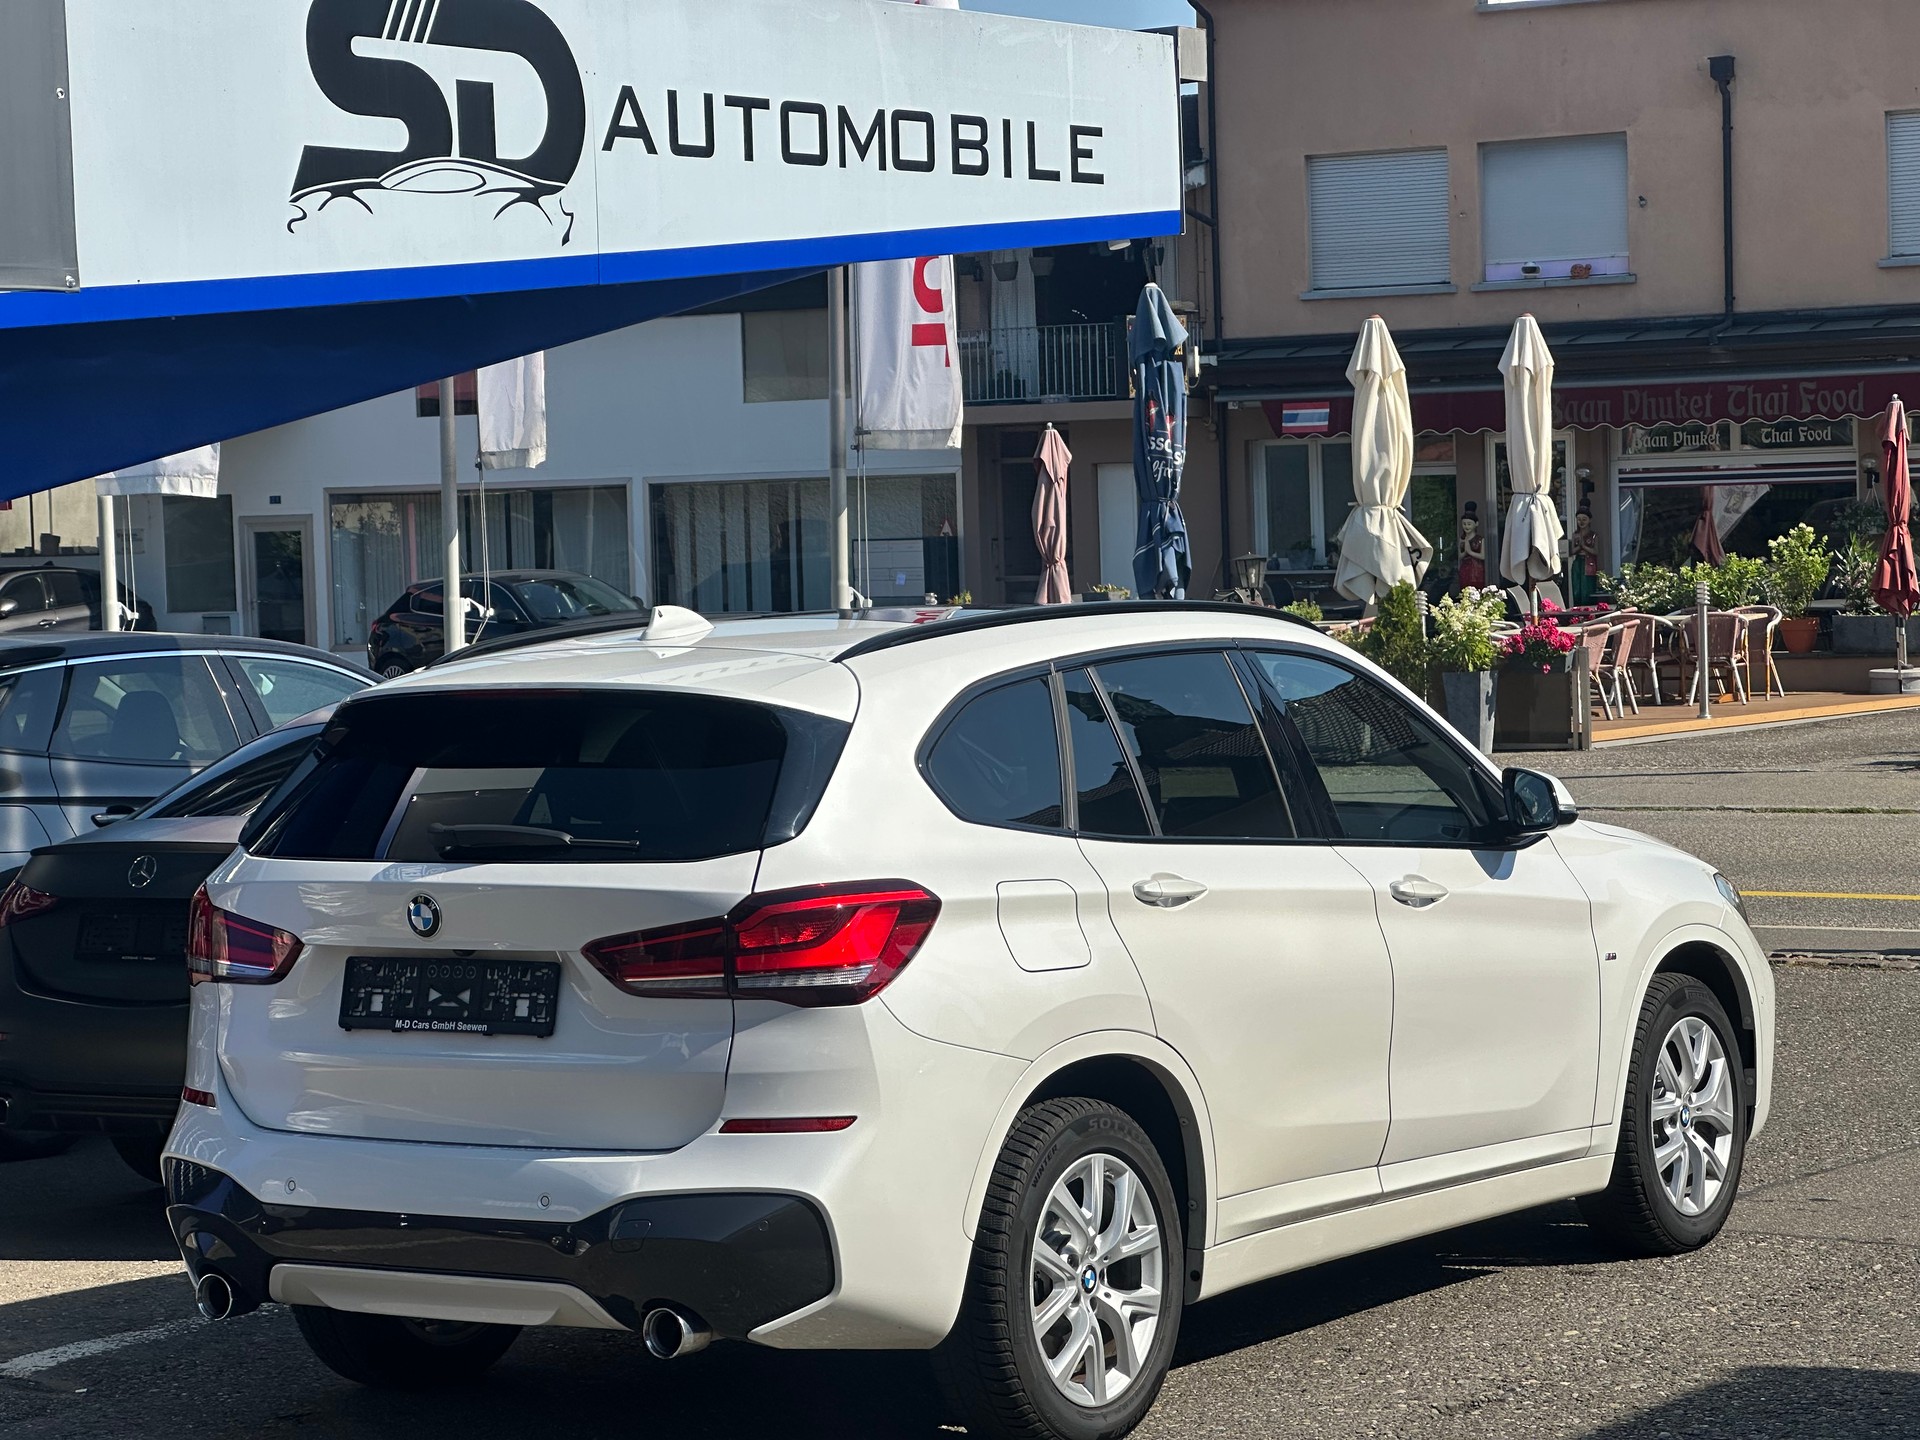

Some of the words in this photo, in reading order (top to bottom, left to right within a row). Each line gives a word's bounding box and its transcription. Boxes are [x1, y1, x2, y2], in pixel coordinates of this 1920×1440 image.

[290, 0, 586, 202] SD
[602, 85, 1105, 185] AUTOMOBILE
[1622, 387, 1713, 422] Phuket
[1727, 384, 1790, 418] Thai
[1799, 380, 1865, 414] Food
[1673, 430, 1720, 448] Phuket
[1760, 427, 1793, 444] Thai
[1798, 426, 1832, 442] Food
[408, 896, 436, 911] BMW
[395, 1019, 411, 1029] M-D
[412, 1020, 430, 1030] Cars
[431, 1020, 456, 1031] GmbH
[457, 1021, 488, 1032] Seewen
[1032, 1143, 1058, 1188] WINTER
